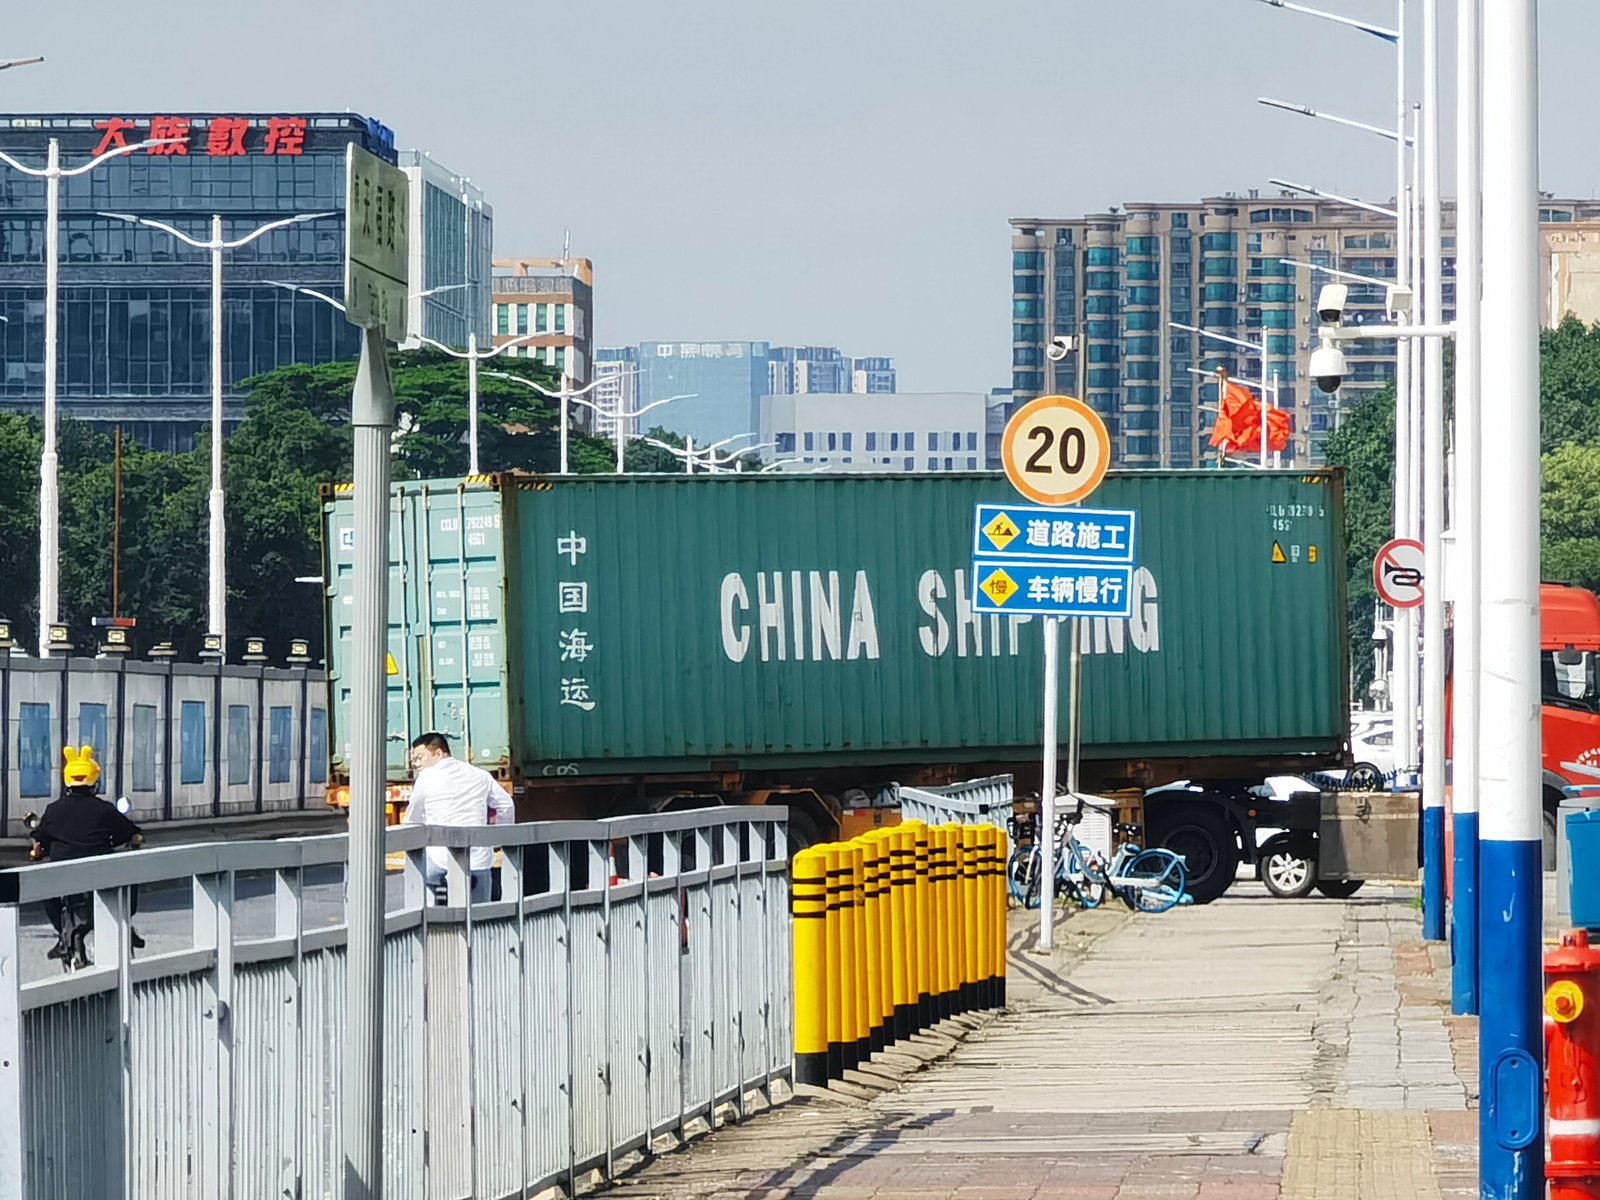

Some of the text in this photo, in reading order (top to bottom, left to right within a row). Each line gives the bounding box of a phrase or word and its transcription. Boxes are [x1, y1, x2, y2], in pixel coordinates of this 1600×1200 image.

[1025, 426, 1085, 474] 20
[1026, 519, 1125, 549] 道路施工
[988, 579, 1009, 595] 慢
[1027, 576, 1124, 604] 车辆慢行
[557, 530, 597, 711] 中国海运
[720, 570, 880, 662] CHINA
